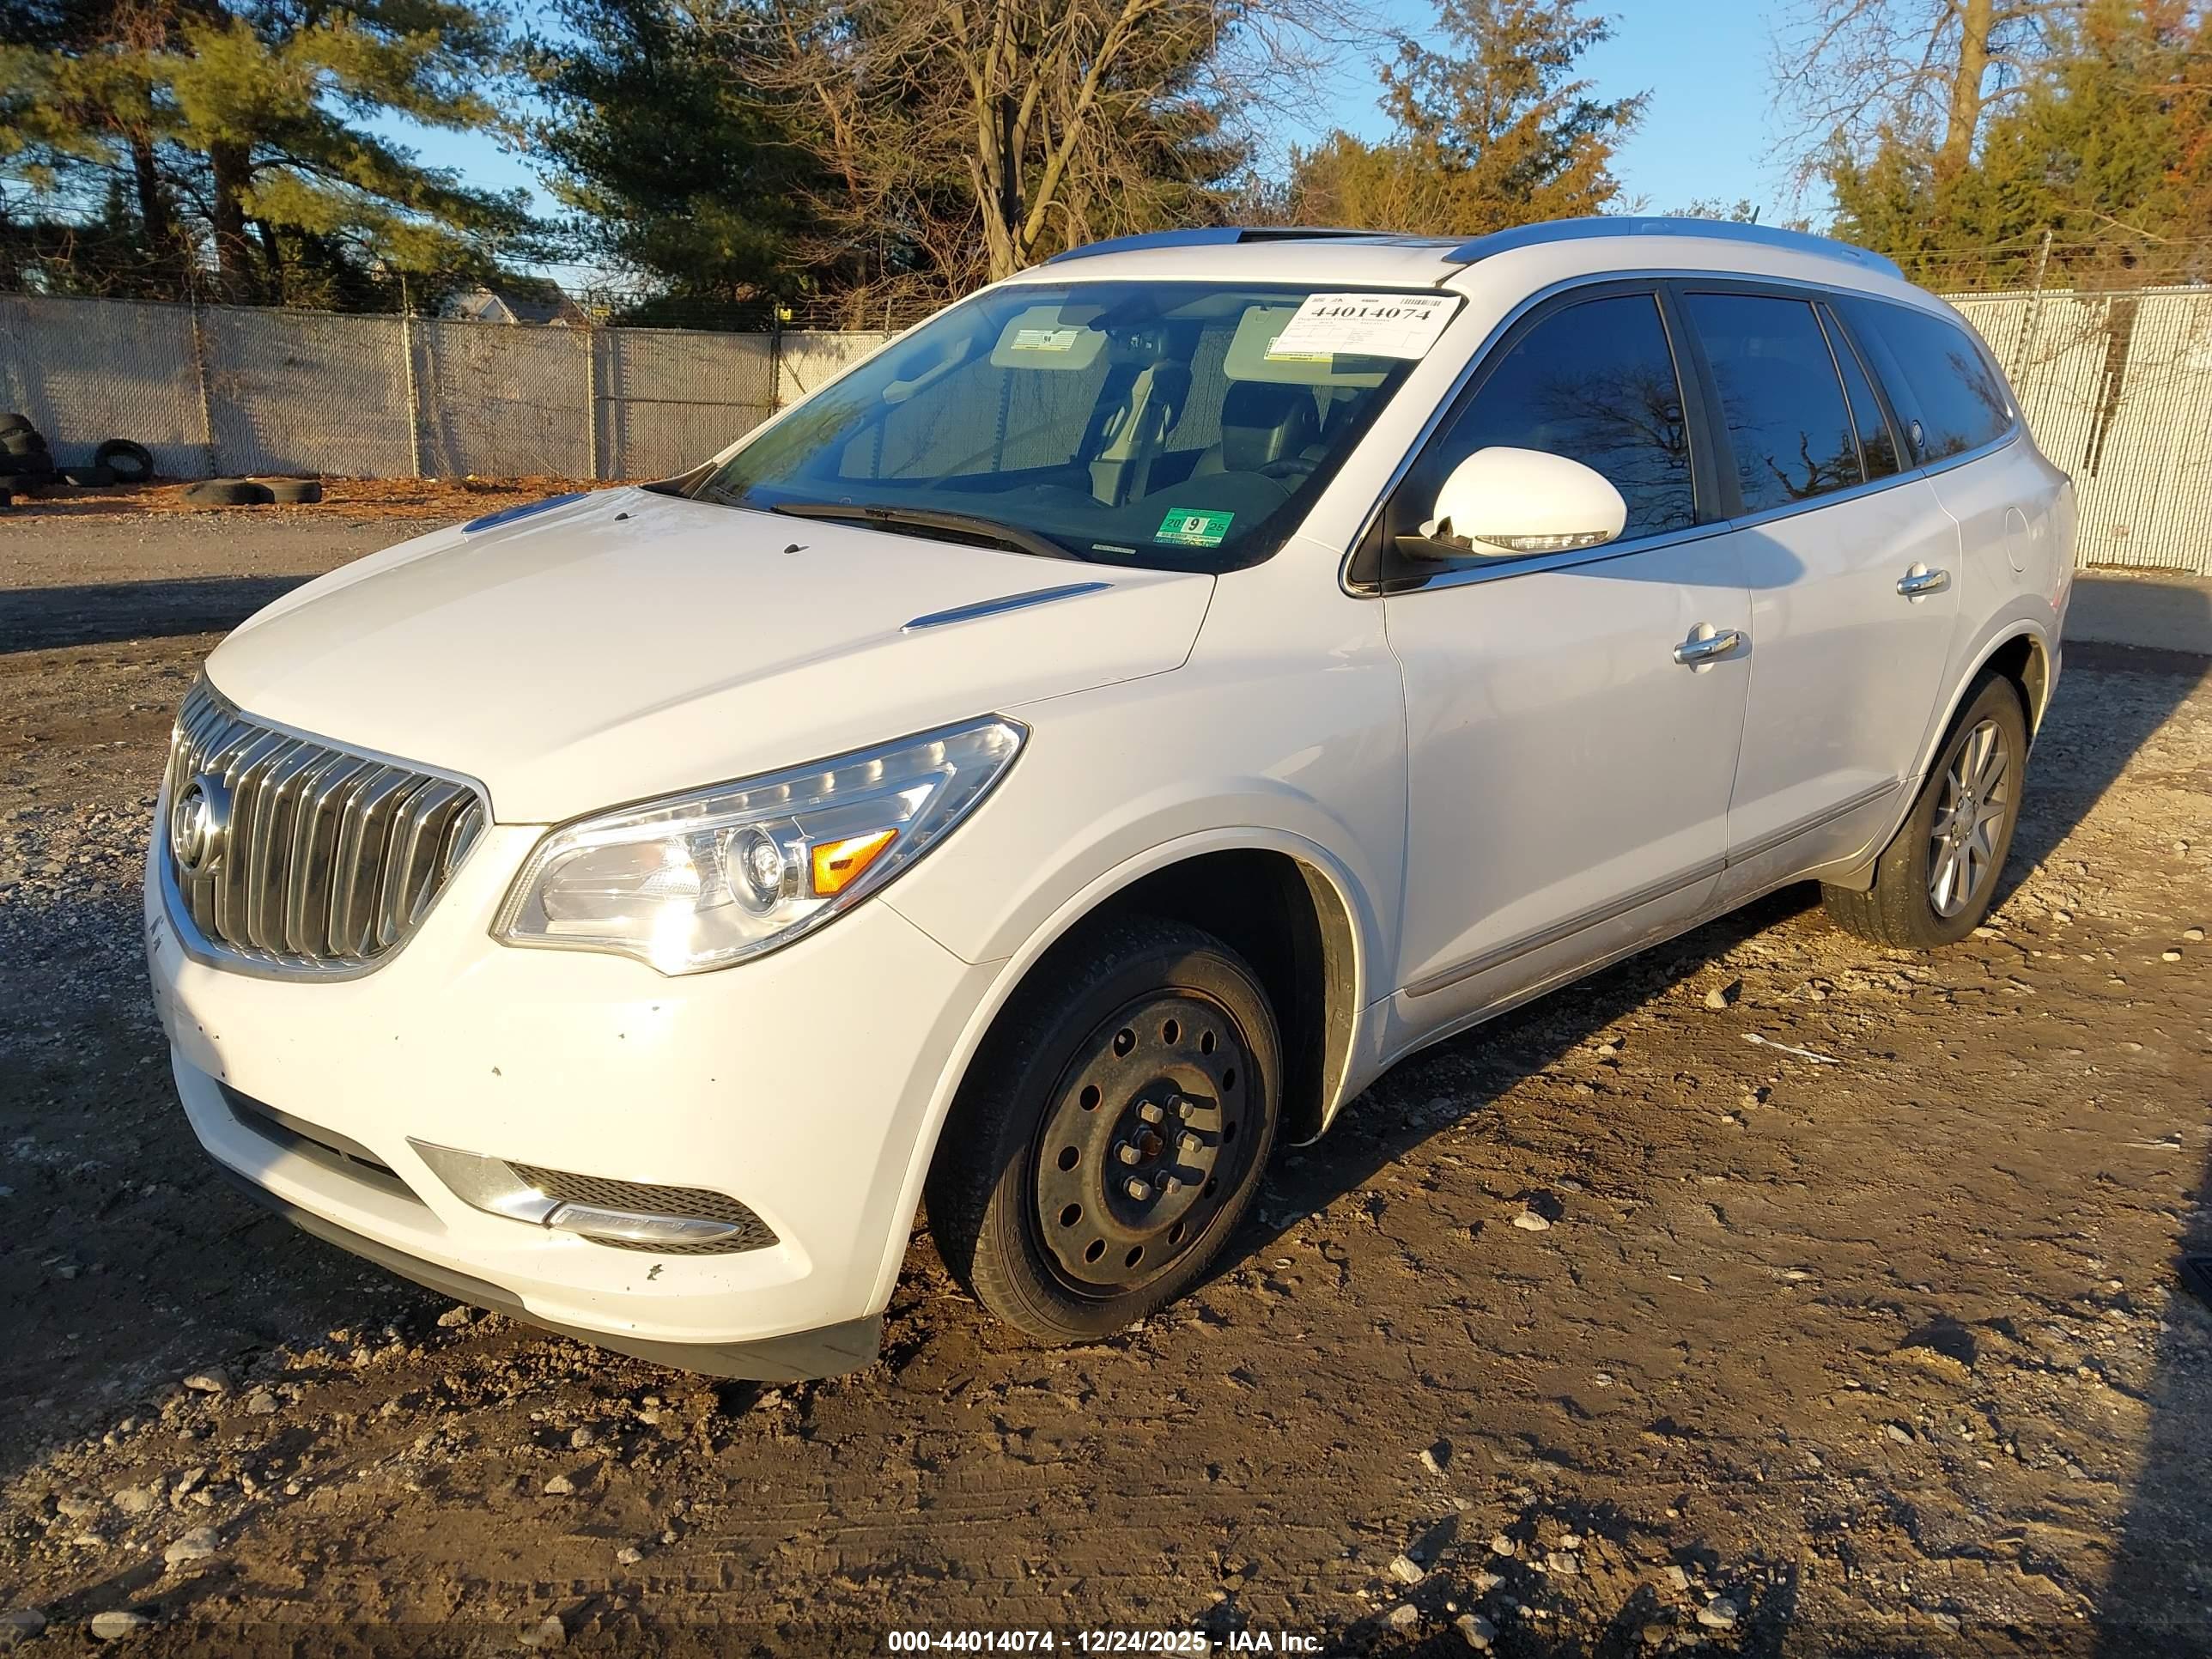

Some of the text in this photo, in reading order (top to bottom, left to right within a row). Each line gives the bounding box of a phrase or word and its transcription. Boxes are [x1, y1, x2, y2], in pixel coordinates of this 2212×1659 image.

[1311, 306, 1432, 320] 44014074
[1166, 518, 1226, 532] 20 9 25
